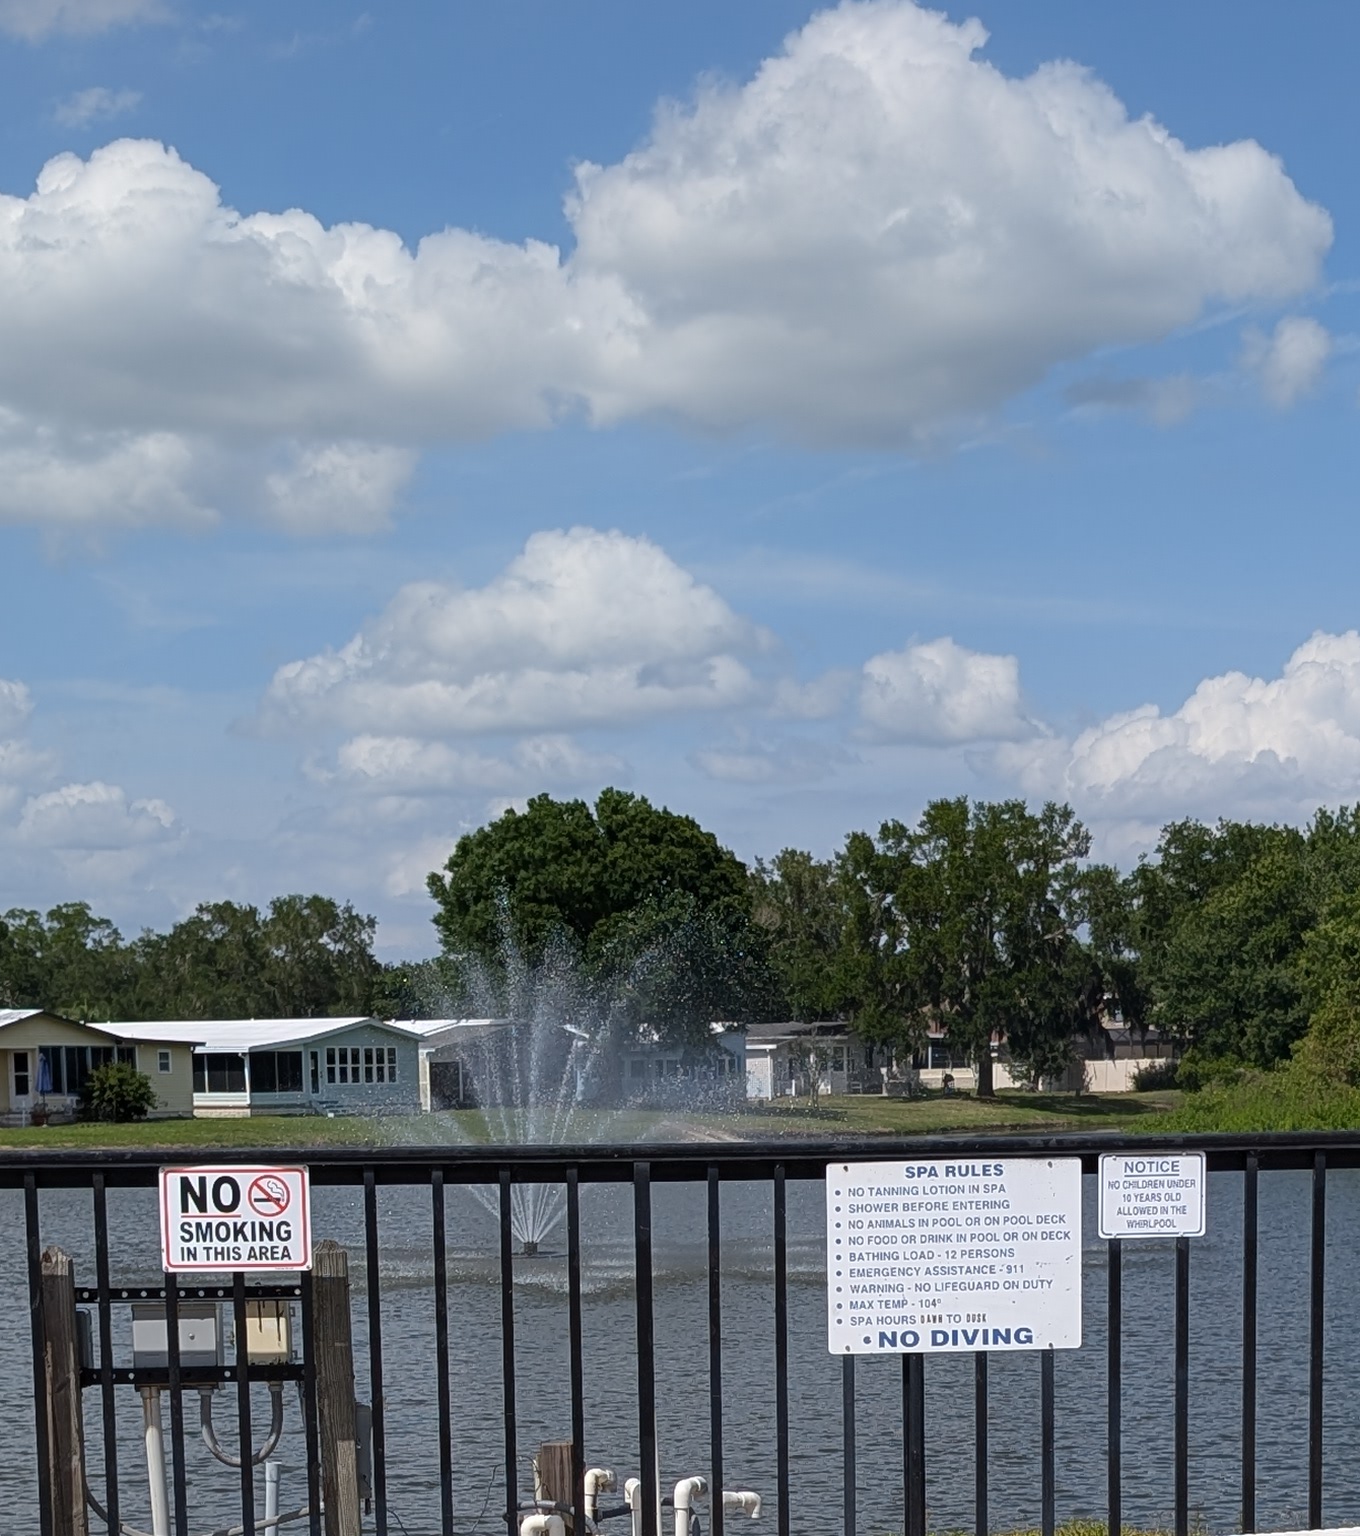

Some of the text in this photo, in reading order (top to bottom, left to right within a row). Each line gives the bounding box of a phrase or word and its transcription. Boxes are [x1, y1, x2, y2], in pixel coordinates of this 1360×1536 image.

[905, 1164, 1004, 1179] SPA RULES
[1124, 1160, 1180, 1173] NOTICE
[848, 1184, 1006, 1197] NO TANNING LOTION IN SPA
[1108, 1179, 1196, 1190] NO CHILDREN UNDER
[180, 1176, 241, 1214] NO
[1123, 1193, 1181, 1202] 10 YEARS OLD
[849, 1200, 1010, 1213] SHOWER BEFORE ENTERING
[1117, 1205, 1187, 1216] ALLOWED IN THE
[848, 1214, 1066, 1230] NO ANIMALS IN POOL OR ON POOL DECK
[1126, 1219, 1177, 1228] WHIRLPOOL
[180, 1221, 292, 1243] SMOKING
[848, 1231, 1071, 1246] NO FOOD OR DRINK IN POOL OR ON DECK
[180, 1246, 292, 1261] IN THIS AREA
[849, 1251, 899, 1262] BATHING
[903, 1250, 935, 1261] LOAD
[945, 1250, 957, 1260] 12
[961, 1248, 1015, 1259] PERSONS
[849, 1267, 921, 1278] EMERGENCY
[925, 1264, 996, 1276] ASSISTANCE
[1006, 1265, 1024, 1274] 911
[850, 1284, 904, 1294] WARNING
[915, 1283, 931, 1292] NO
[935, 1281, 1000, 1292] LIFEGUARD
[1003, 1280, 1020, 1290] ON
[1023, 1280, 1053, 1290] DUTY
[849, 1300, 874, 1310] MAX
[878, 1300, 908, 1309] TEMP
[850, 1316, 873, 1326] SPA
[877, 1315, 917, 1325] HOURS
[946, 1314, 962, 1324] TO
[966, 1313, 987, 1323] DUSK
[879, 1327, 1033, 1348] NO DIVING
